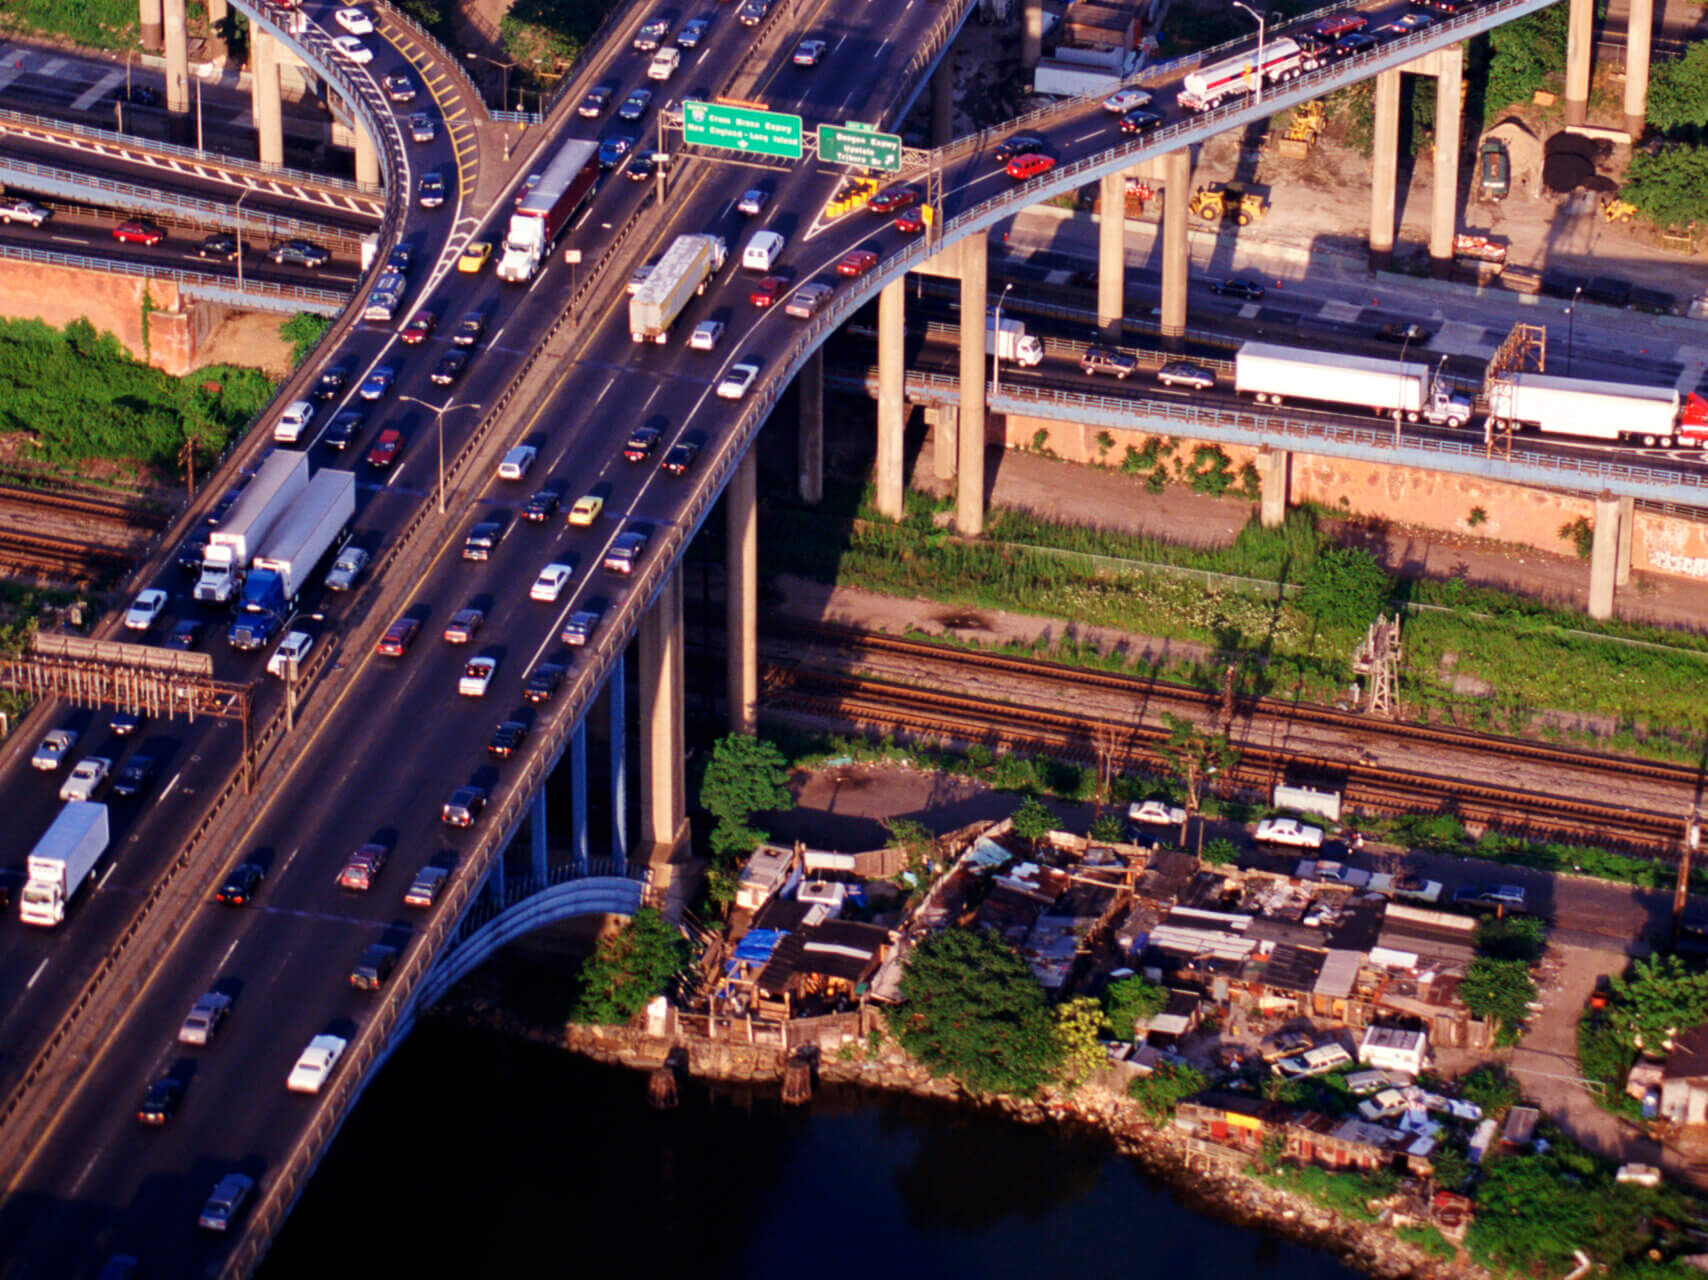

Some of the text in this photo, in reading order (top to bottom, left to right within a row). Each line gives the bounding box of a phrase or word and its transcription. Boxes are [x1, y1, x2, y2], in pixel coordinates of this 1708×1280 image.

[708, 114, 731, 125] Cross
[735, 118, 760, 129] Bronx
[764, 122, 792, 135] Expwy
[687, 123, 705, 133] New
[709, 126, 743, 139] England
[749, 132, 769, 143] Long
[772, 135, 798, 146] Island
[836, 132, 897, 151] Deegan Expwy
[836, 151, 866, 163] Triboro
[843, 144, 875, 156] Upstate
